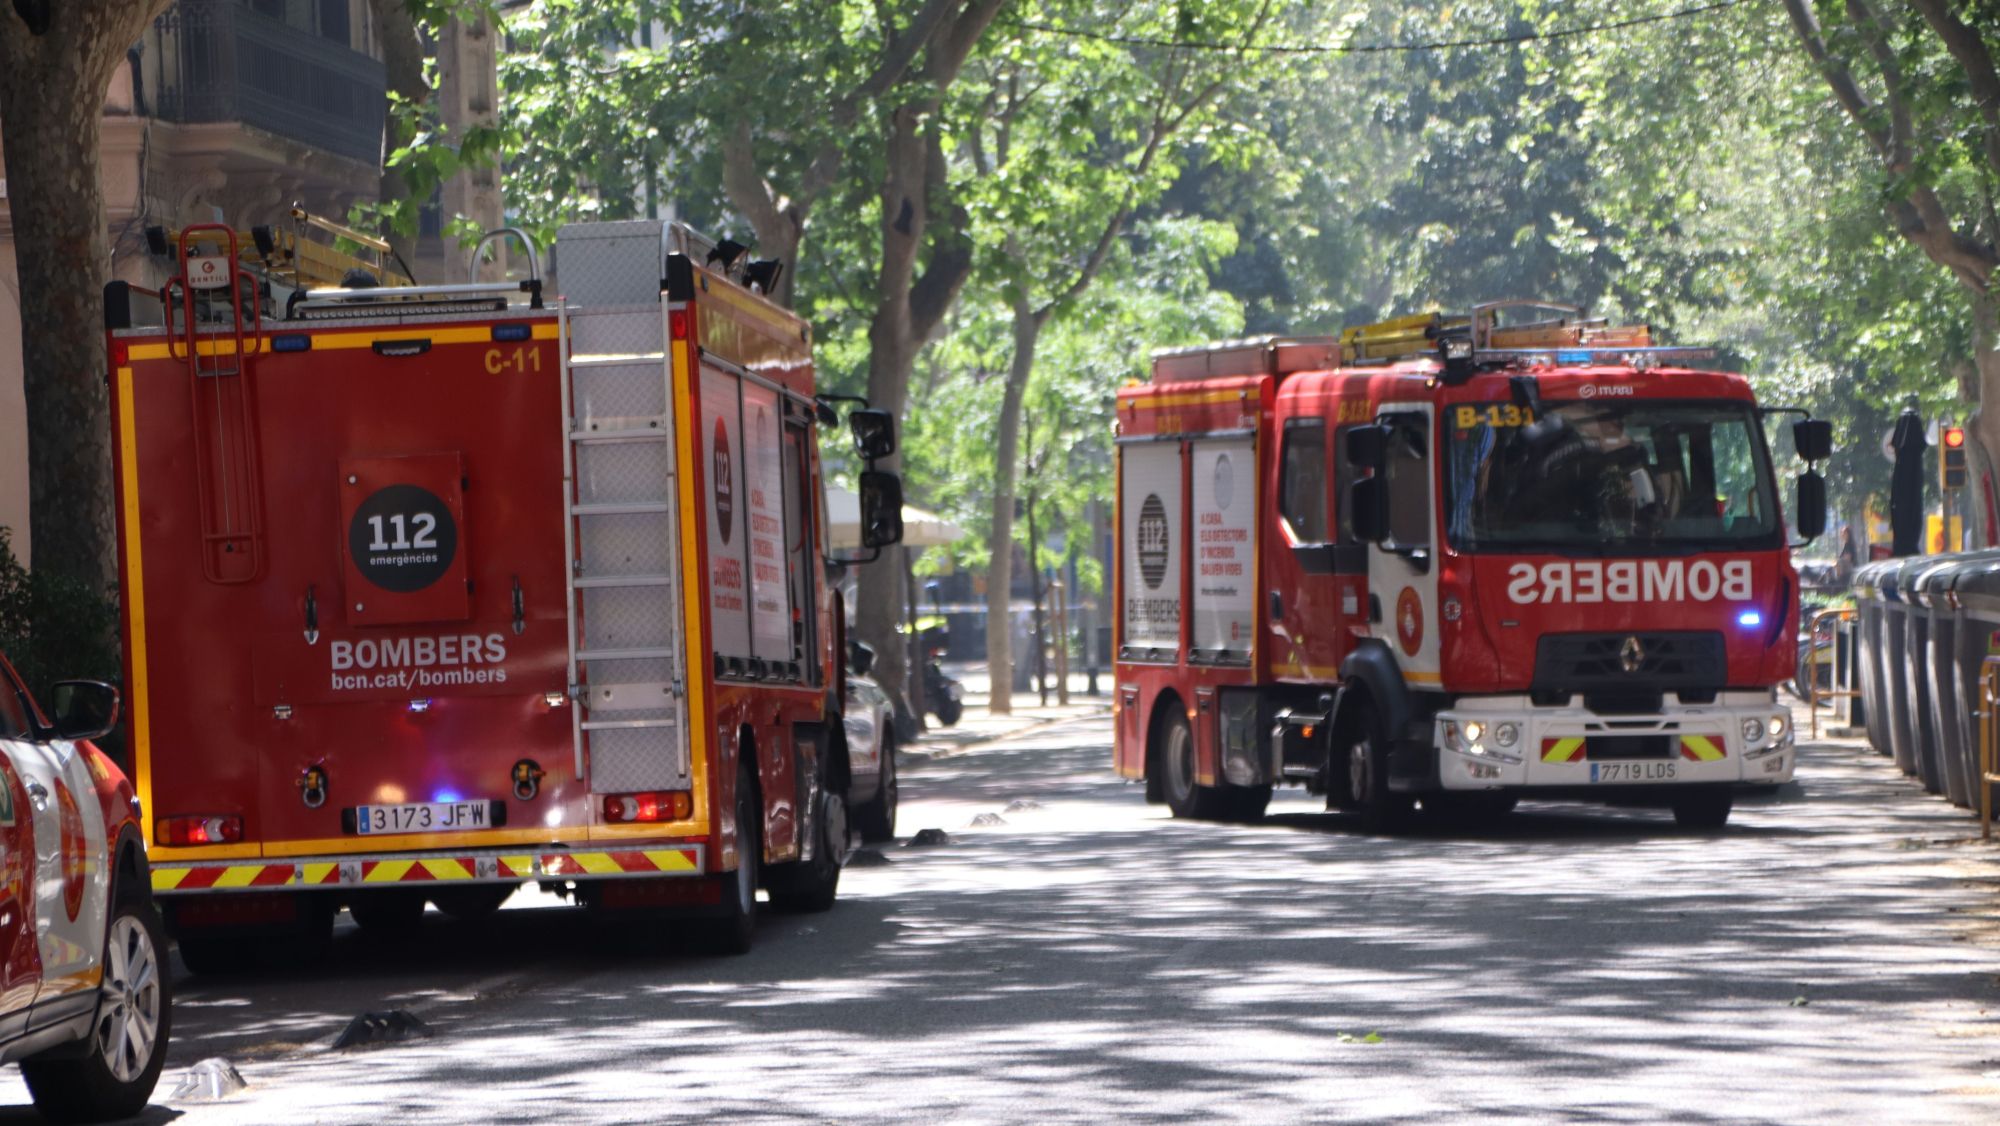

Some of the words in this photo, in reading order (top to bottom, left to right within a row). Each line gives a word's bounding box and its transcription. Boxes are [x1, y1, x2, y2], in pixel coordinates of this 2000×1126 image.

[485, 346, 541, 375] C-11
[1457, 405, 1534, 428] B-131
[368, 512, 437, 551] 112
[1141, 519, 1164, 552] 112
[1214, 528, 1247, 542] DETECTORS
[369, 553, 438, 567] emergències
[1129, 599, 1180, 623] BOMBERS
[331, 633, 506, 670] BOMBERS
[331, 667, 507, 691] bcn.cat/bombers
[1602, 764, 1641, 780] 7719
[1647, 763, 1676, 779] LDS
[374, 807, 432, 830] 3173
[442, 804, 484, 827] JFW
